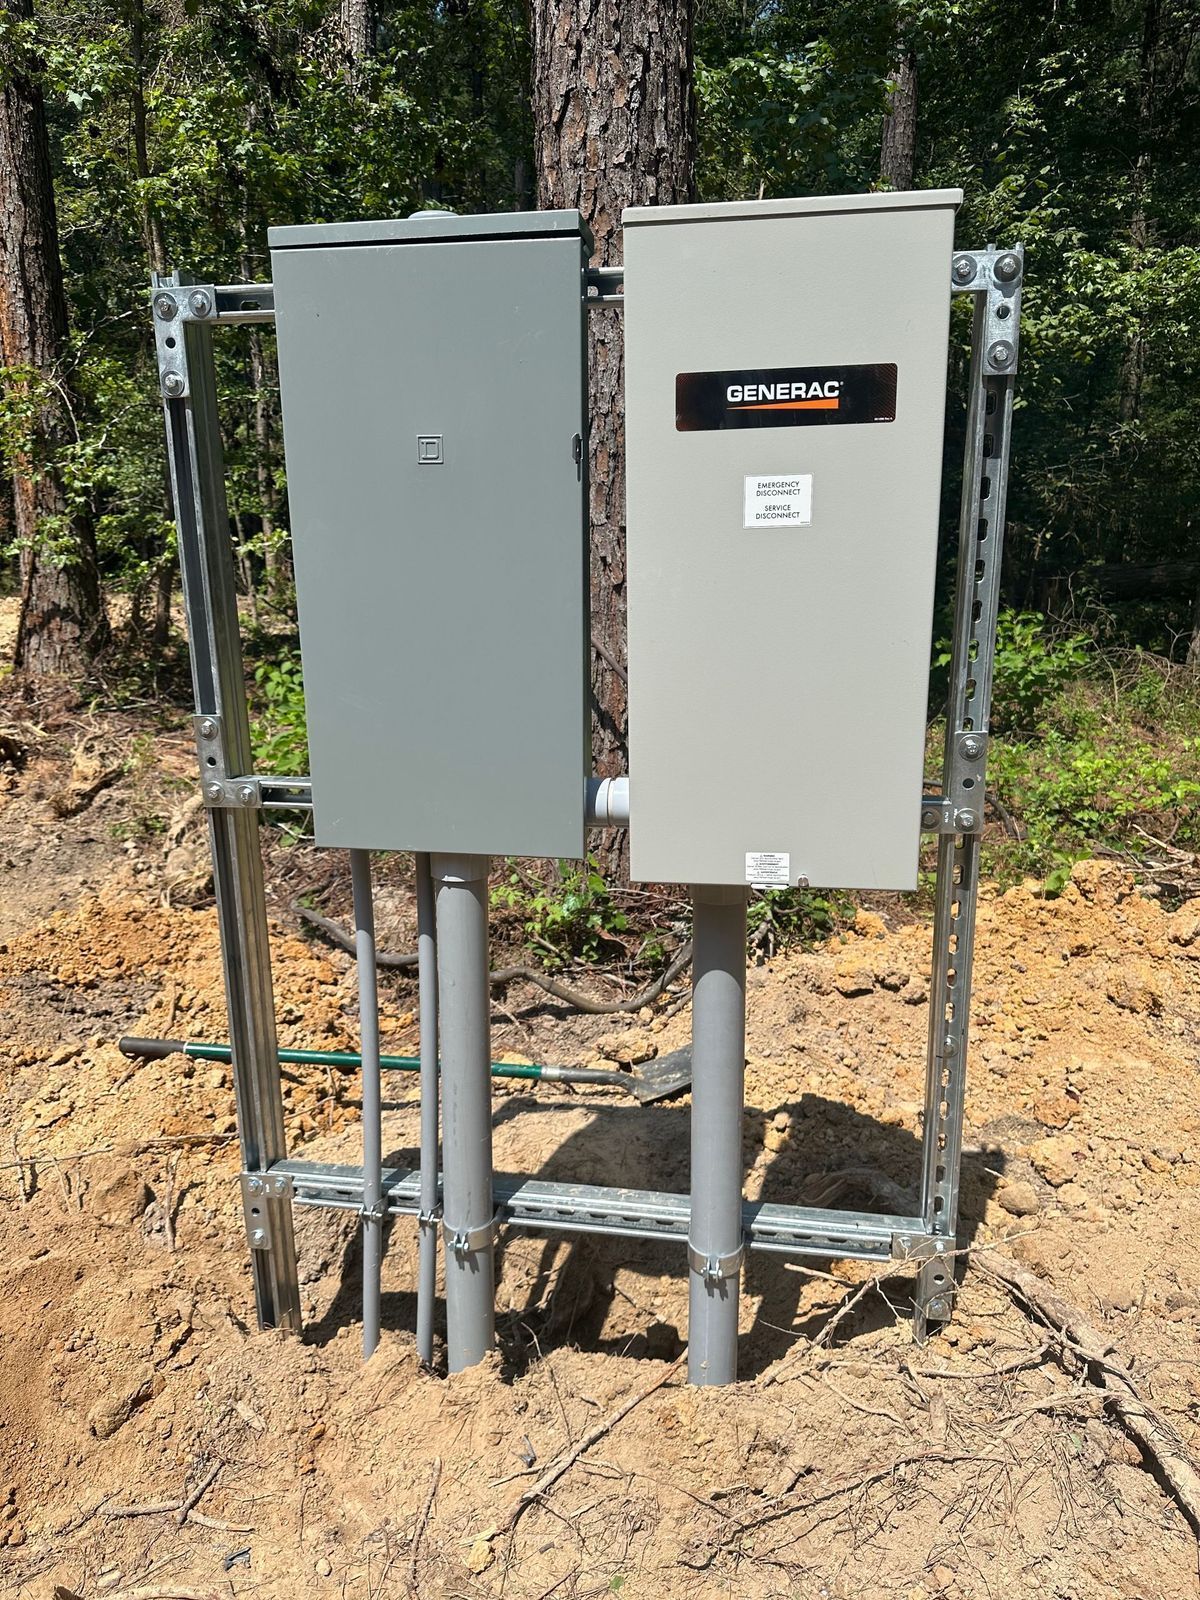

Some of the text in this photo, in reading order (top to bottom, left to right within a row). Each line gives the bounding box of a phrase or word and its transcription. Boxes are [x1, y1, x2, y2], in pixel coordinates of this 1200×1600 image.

[727, 381, 840, 402] GENERAC
[757, 481, 800, 489] EMERGENCY
[756, 489, 801, 497] DISCONNECT
[764, 504, 791, 512] SERVICE
[755, 511, 800, 520] DISCONNECT
